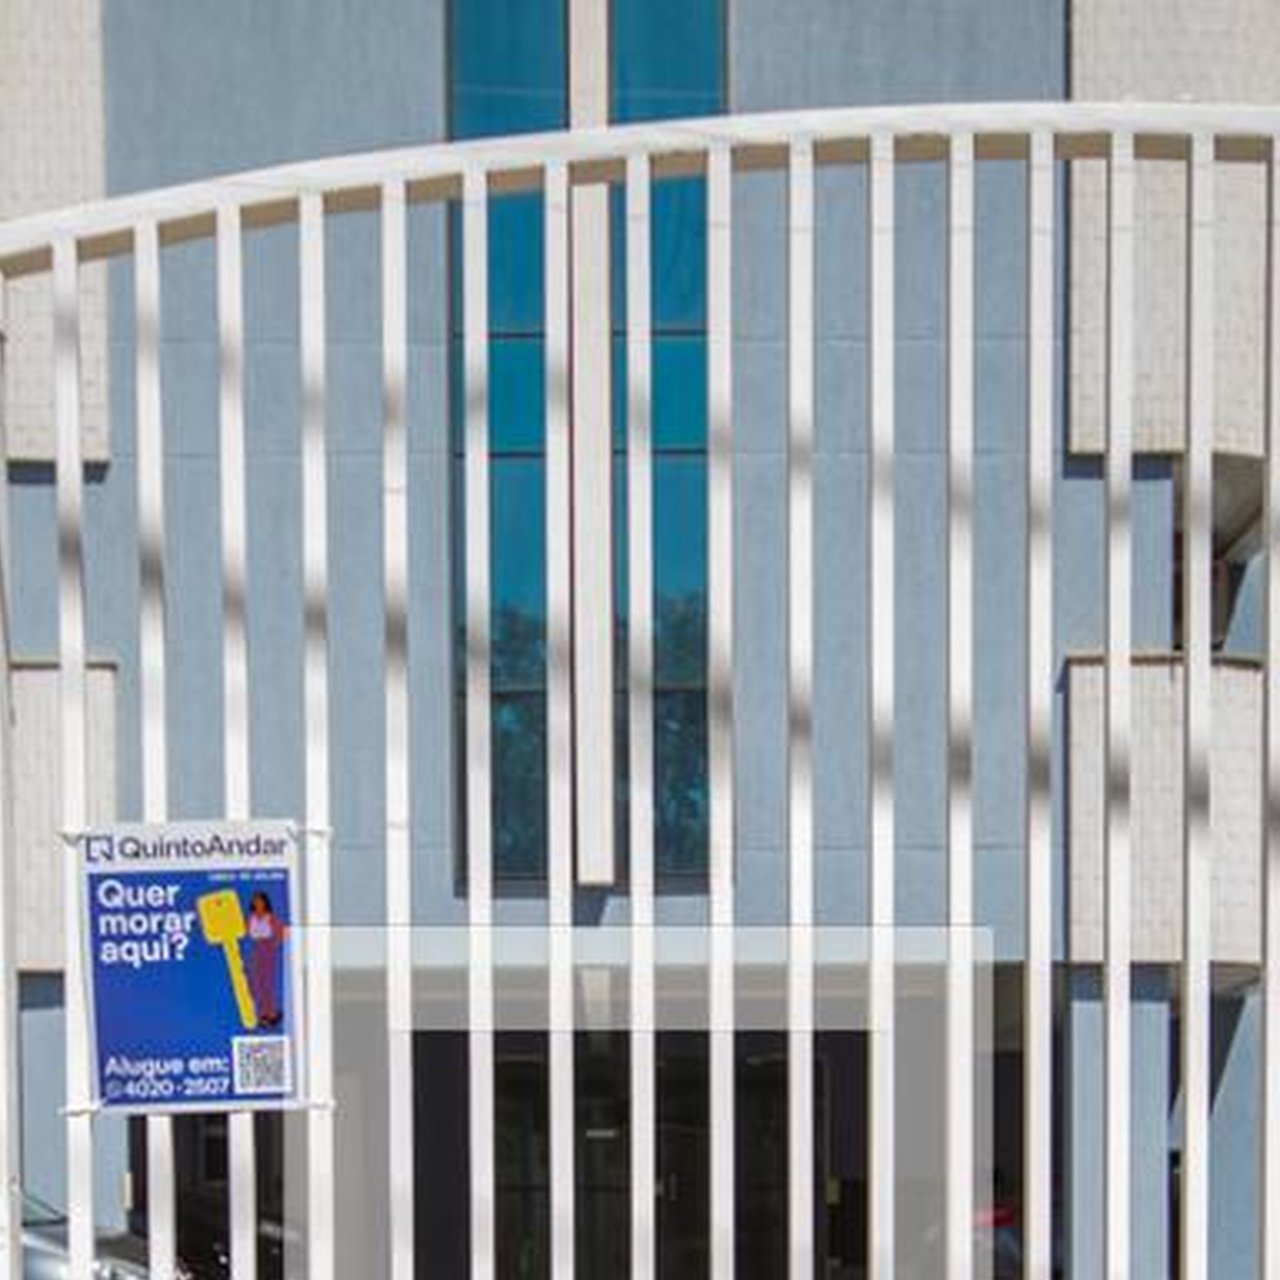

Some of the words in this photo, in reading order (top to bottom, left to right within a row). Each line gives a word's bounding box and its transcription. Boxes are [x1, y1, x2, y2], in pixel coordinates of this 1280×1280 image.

[119, 834, 287, 858] QuintoAndar
[98, 879, 180, 909] Quer
[99, 910, 194, 935] morar
[100, 932, 188, 966] aqui?
[105, 1056, 184, 1078] Alugue
[188, 1057, 231, 1075] em:
